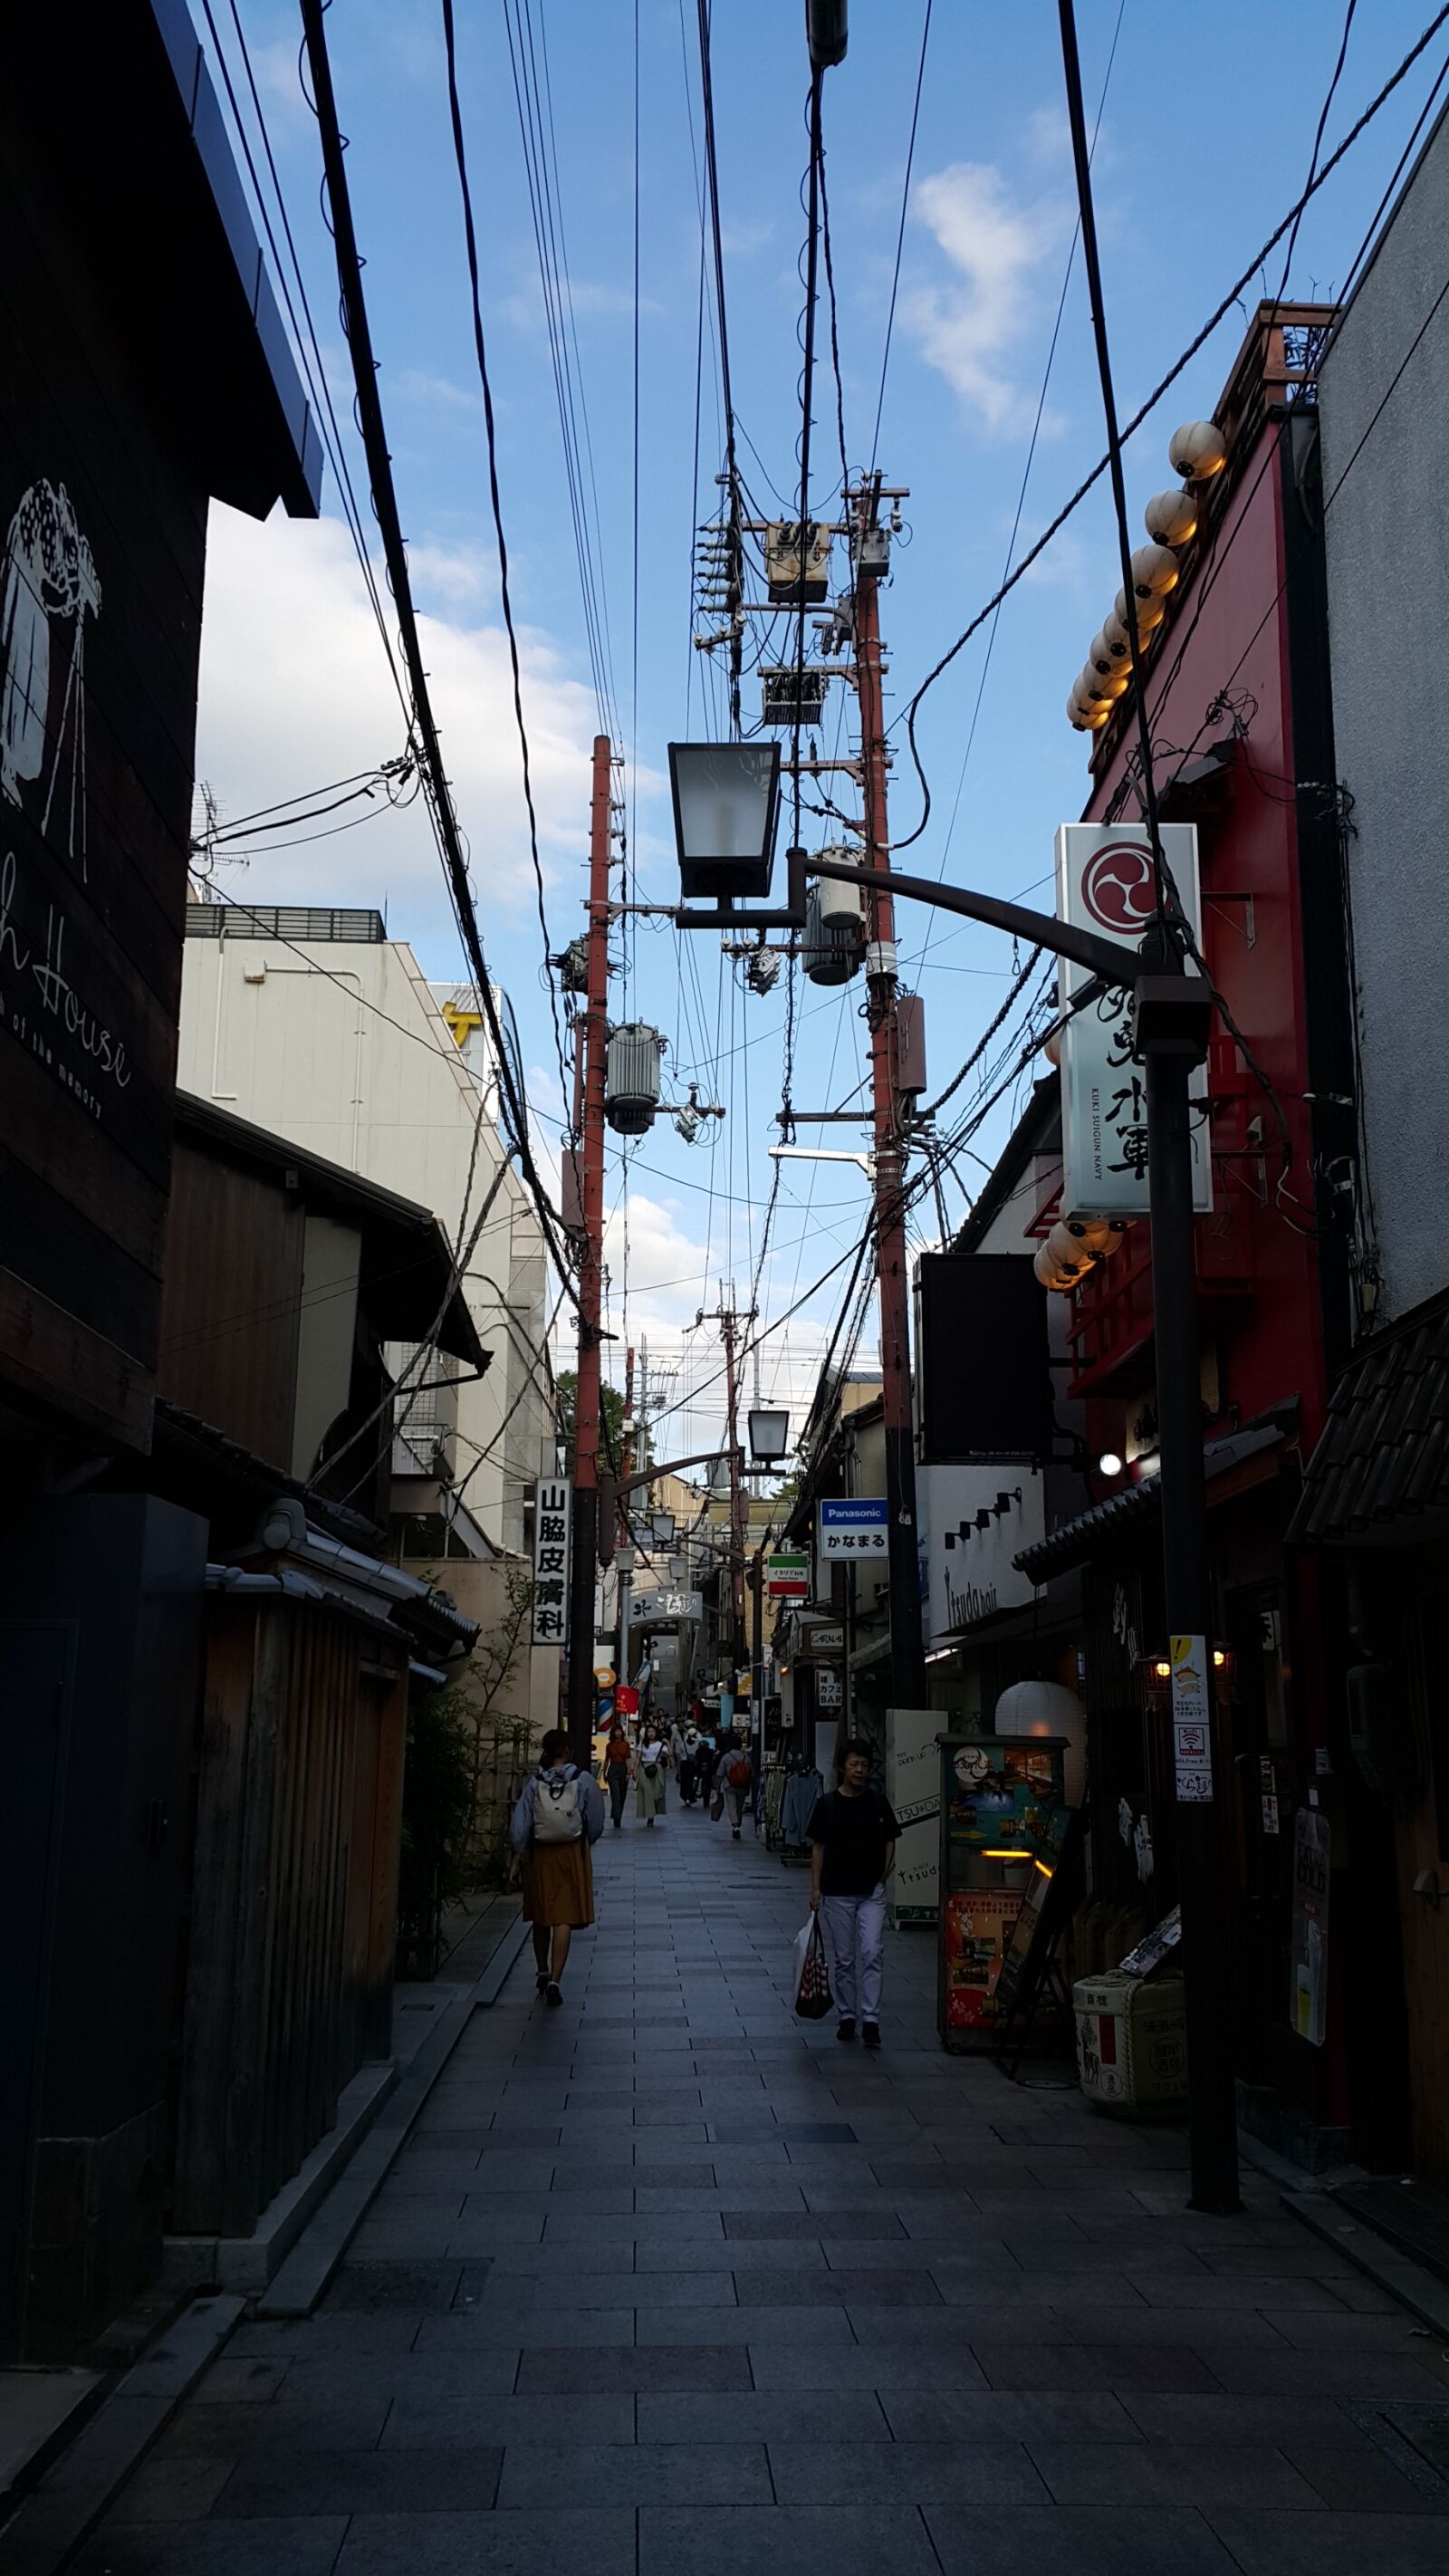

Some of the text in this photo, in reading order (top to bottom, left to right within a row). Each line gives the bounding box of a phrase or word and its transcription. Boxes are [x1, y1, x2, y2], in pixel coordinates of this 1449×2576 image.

[32, 903, 131, 1087] House
[13, 1013, 102, 1120] of the memory
[1091, 1088, 1103, 1181] KUKI SUIGUN NAVY
[827, 1534, 886, 1548] かなまる
[828, 1507, 882, 1519] Panasonic
[536, 1485, 566, 1639] 山脇皮膚科
[820, 1696, 842, 1704] BAR
